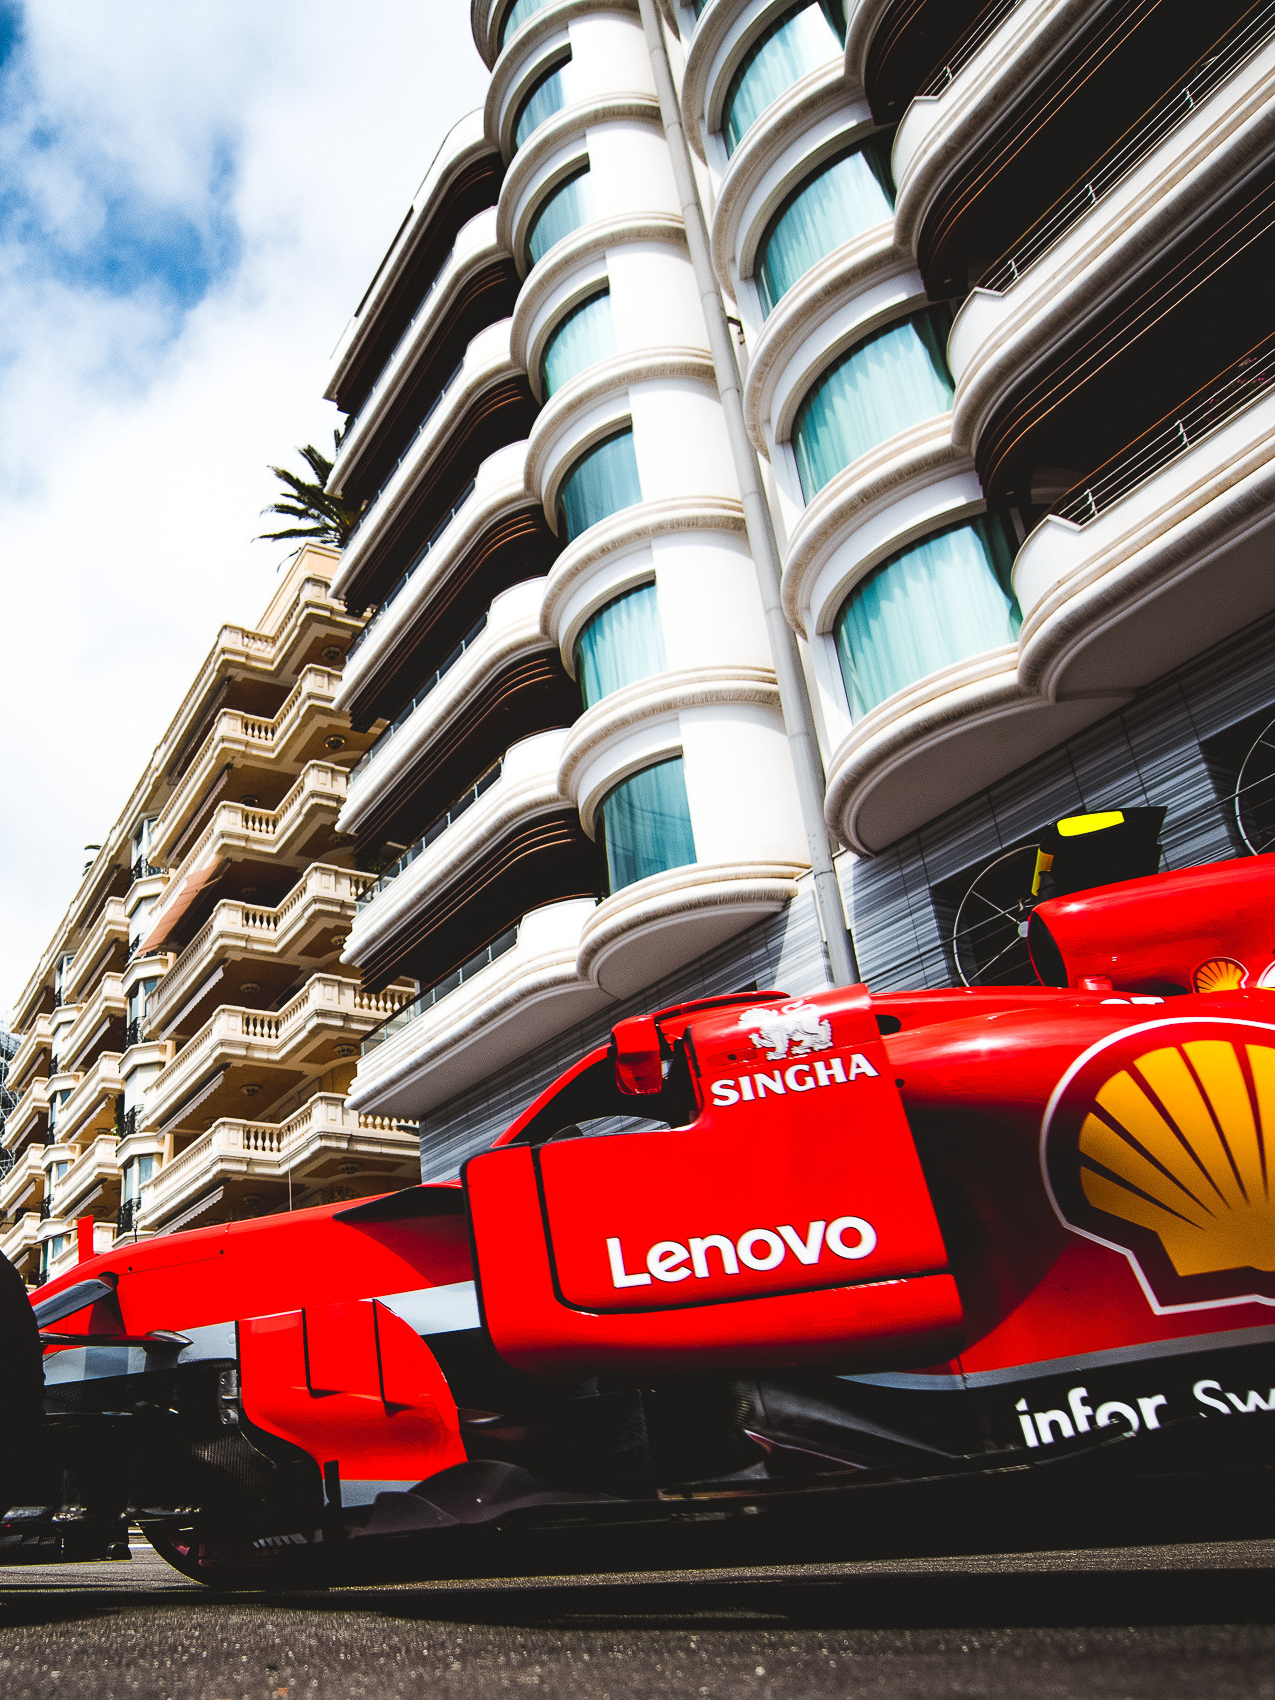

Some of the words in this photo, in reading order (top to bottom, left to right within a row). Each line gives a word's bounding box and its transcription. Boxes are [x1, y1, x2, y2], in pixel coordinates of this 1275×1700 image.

[711, 1053, 879, 1107] SINGHA
[606, 1216, 877, 1288] Lenovo
[1014, 1386, 1168, 1448] infor
